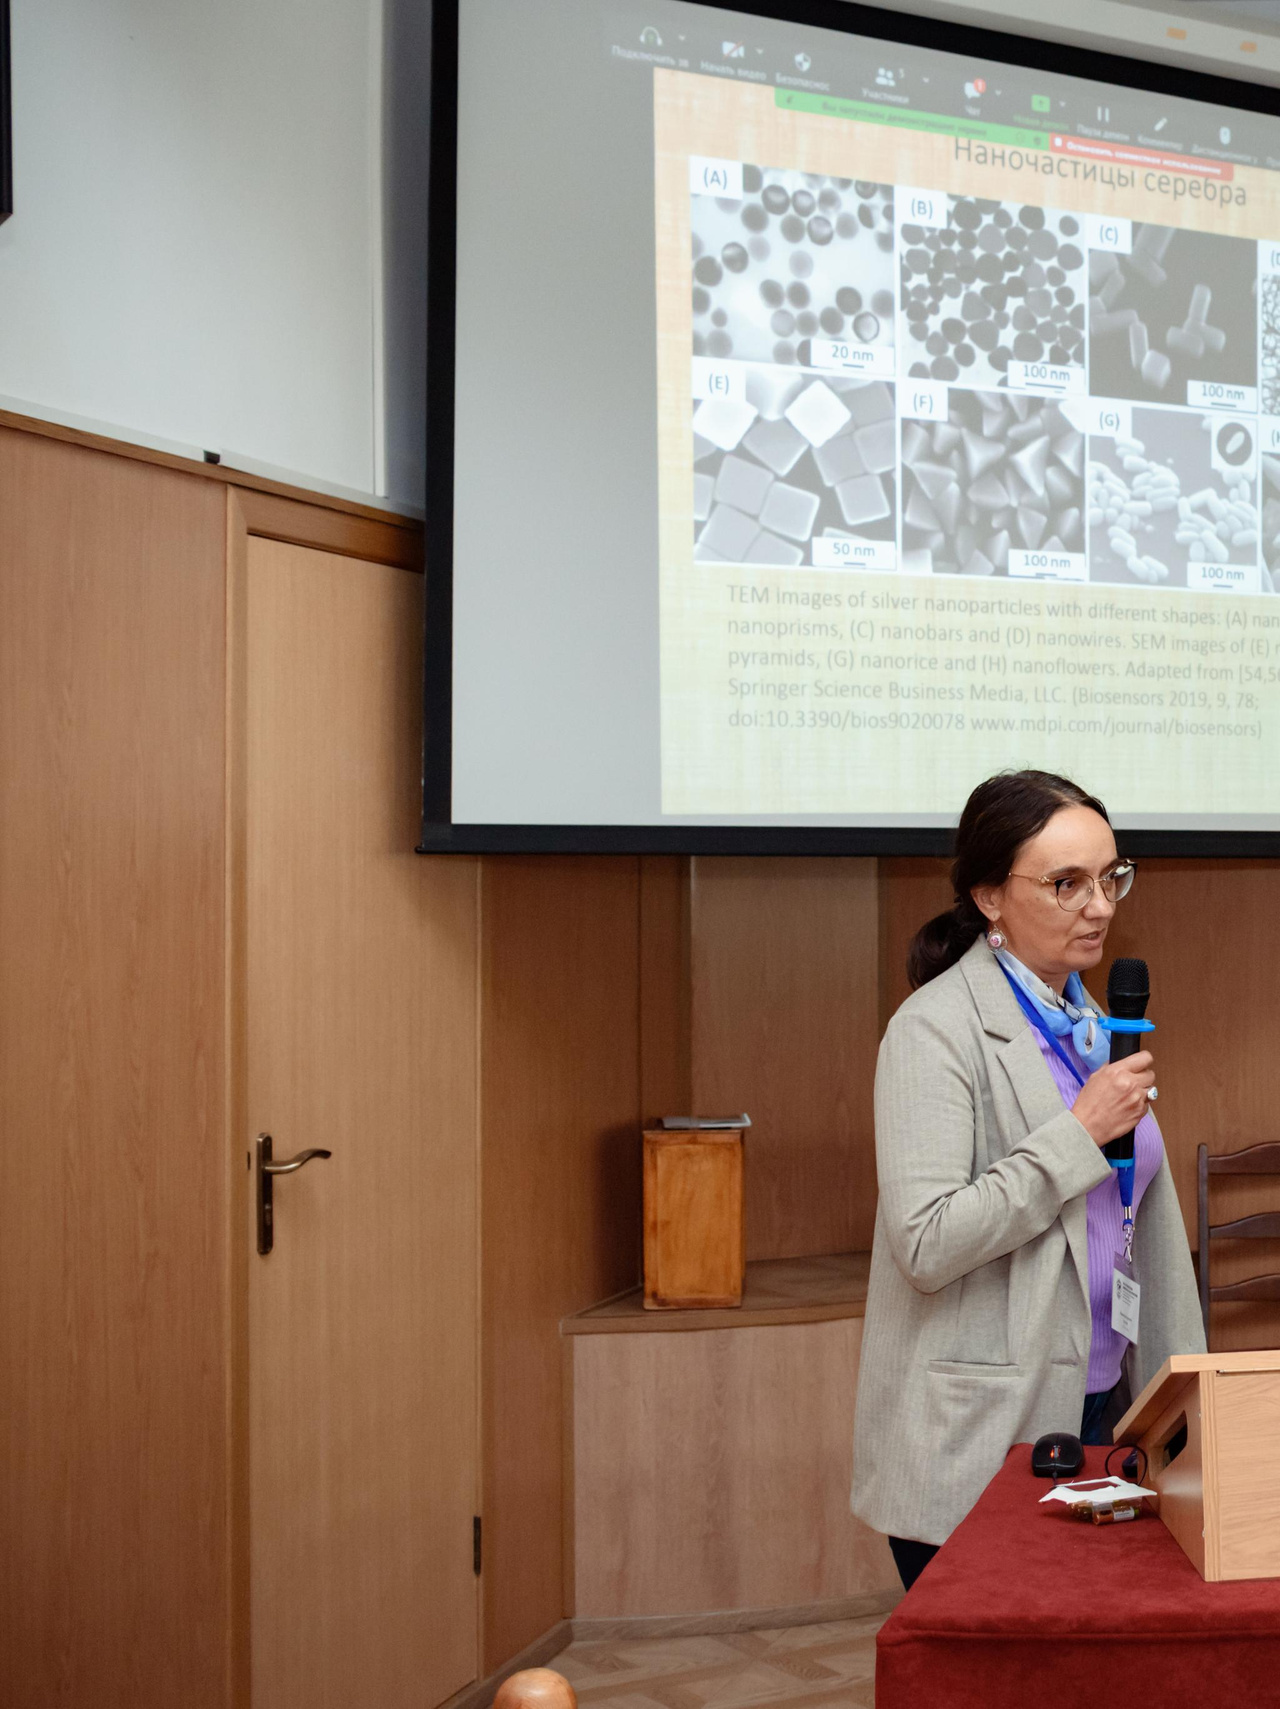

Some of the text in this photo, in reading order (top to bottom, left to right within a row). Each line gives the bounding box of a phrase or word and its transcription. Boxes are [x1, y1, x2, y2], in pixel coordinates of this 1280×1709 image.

[703, 165, 728, 190] (A)
[954, 138, 1248, 208] Наночастицы серебра
[910, 196, 934, 220] (B)
[1099, 222, 1119, 244] (C)
[831, 344, 875, 362] 20 nm
[1023, 364, 1071, 382] 100 nm
[708, 374, 730, 395] (E)
[1201, 383, 1246, 401] 100 nm
[912, 393, 934, 414] (F)
[1099, 409, 1120, 431] (G)
[832, 541, 876, 558] 50 nm
[1023, 553, 1071, 569] 100 nm
[1201, 566, 1246, 582] 100 nm
[727, 585, 769, 604] TEM
[777, 588, 842, 610] images
[847, 591, 867, 607] of
[872, 592, 918, 611] silver
[925, 596, 1042, 617] nanoparticles
[1046, 601, 1082, 618] with
[1088, 604, 1158, 622] different
[1162, 608, 1221, 628] shapes:
[1225, 610, 1248, 629] (A)
[728, 618, 844, 641] nanoprisms,
[850, 619, 875, 642] (C)
[881, 622, 963, 642] nanobars
[968, 626, 1001, 644] and
[1006, 627, 1031, 648] (D)
[1036, 630, 1126, 650] nanowires.
[1132, 635, 1166, 652] SEM
[1171, 637, 1226, 658] images
[1230, 638, 1246, 654] of
[1250, 638, 1270, 657] (E)
[728, 649, 821, 671] pyramids,
[826, 650, 855, 672] (G)
[860, 653, 939, 671] nanorice
[944, 655, 976, 673] and
[981, 656, 1008, 677] (H)
[1012, 657, 1120, 677] nanoflowers.
[1125, 661, 1192, 682] Adapted
[1196, 663, 1234, 681] from
[728, 678, 808, 700] Springer
[813, 680, 883, 699] Science
[889, 681, 965, 700] Business
[1072, 686, 1164, 707] (Biosensors
[1169, 690, 1209, 709] 2019,
[1216, 692, 1231, 709] 9,
[728, 709, 1263, 739] doi:10.3390/bios9020078 www.mdpi.com/journal/biosensors)
